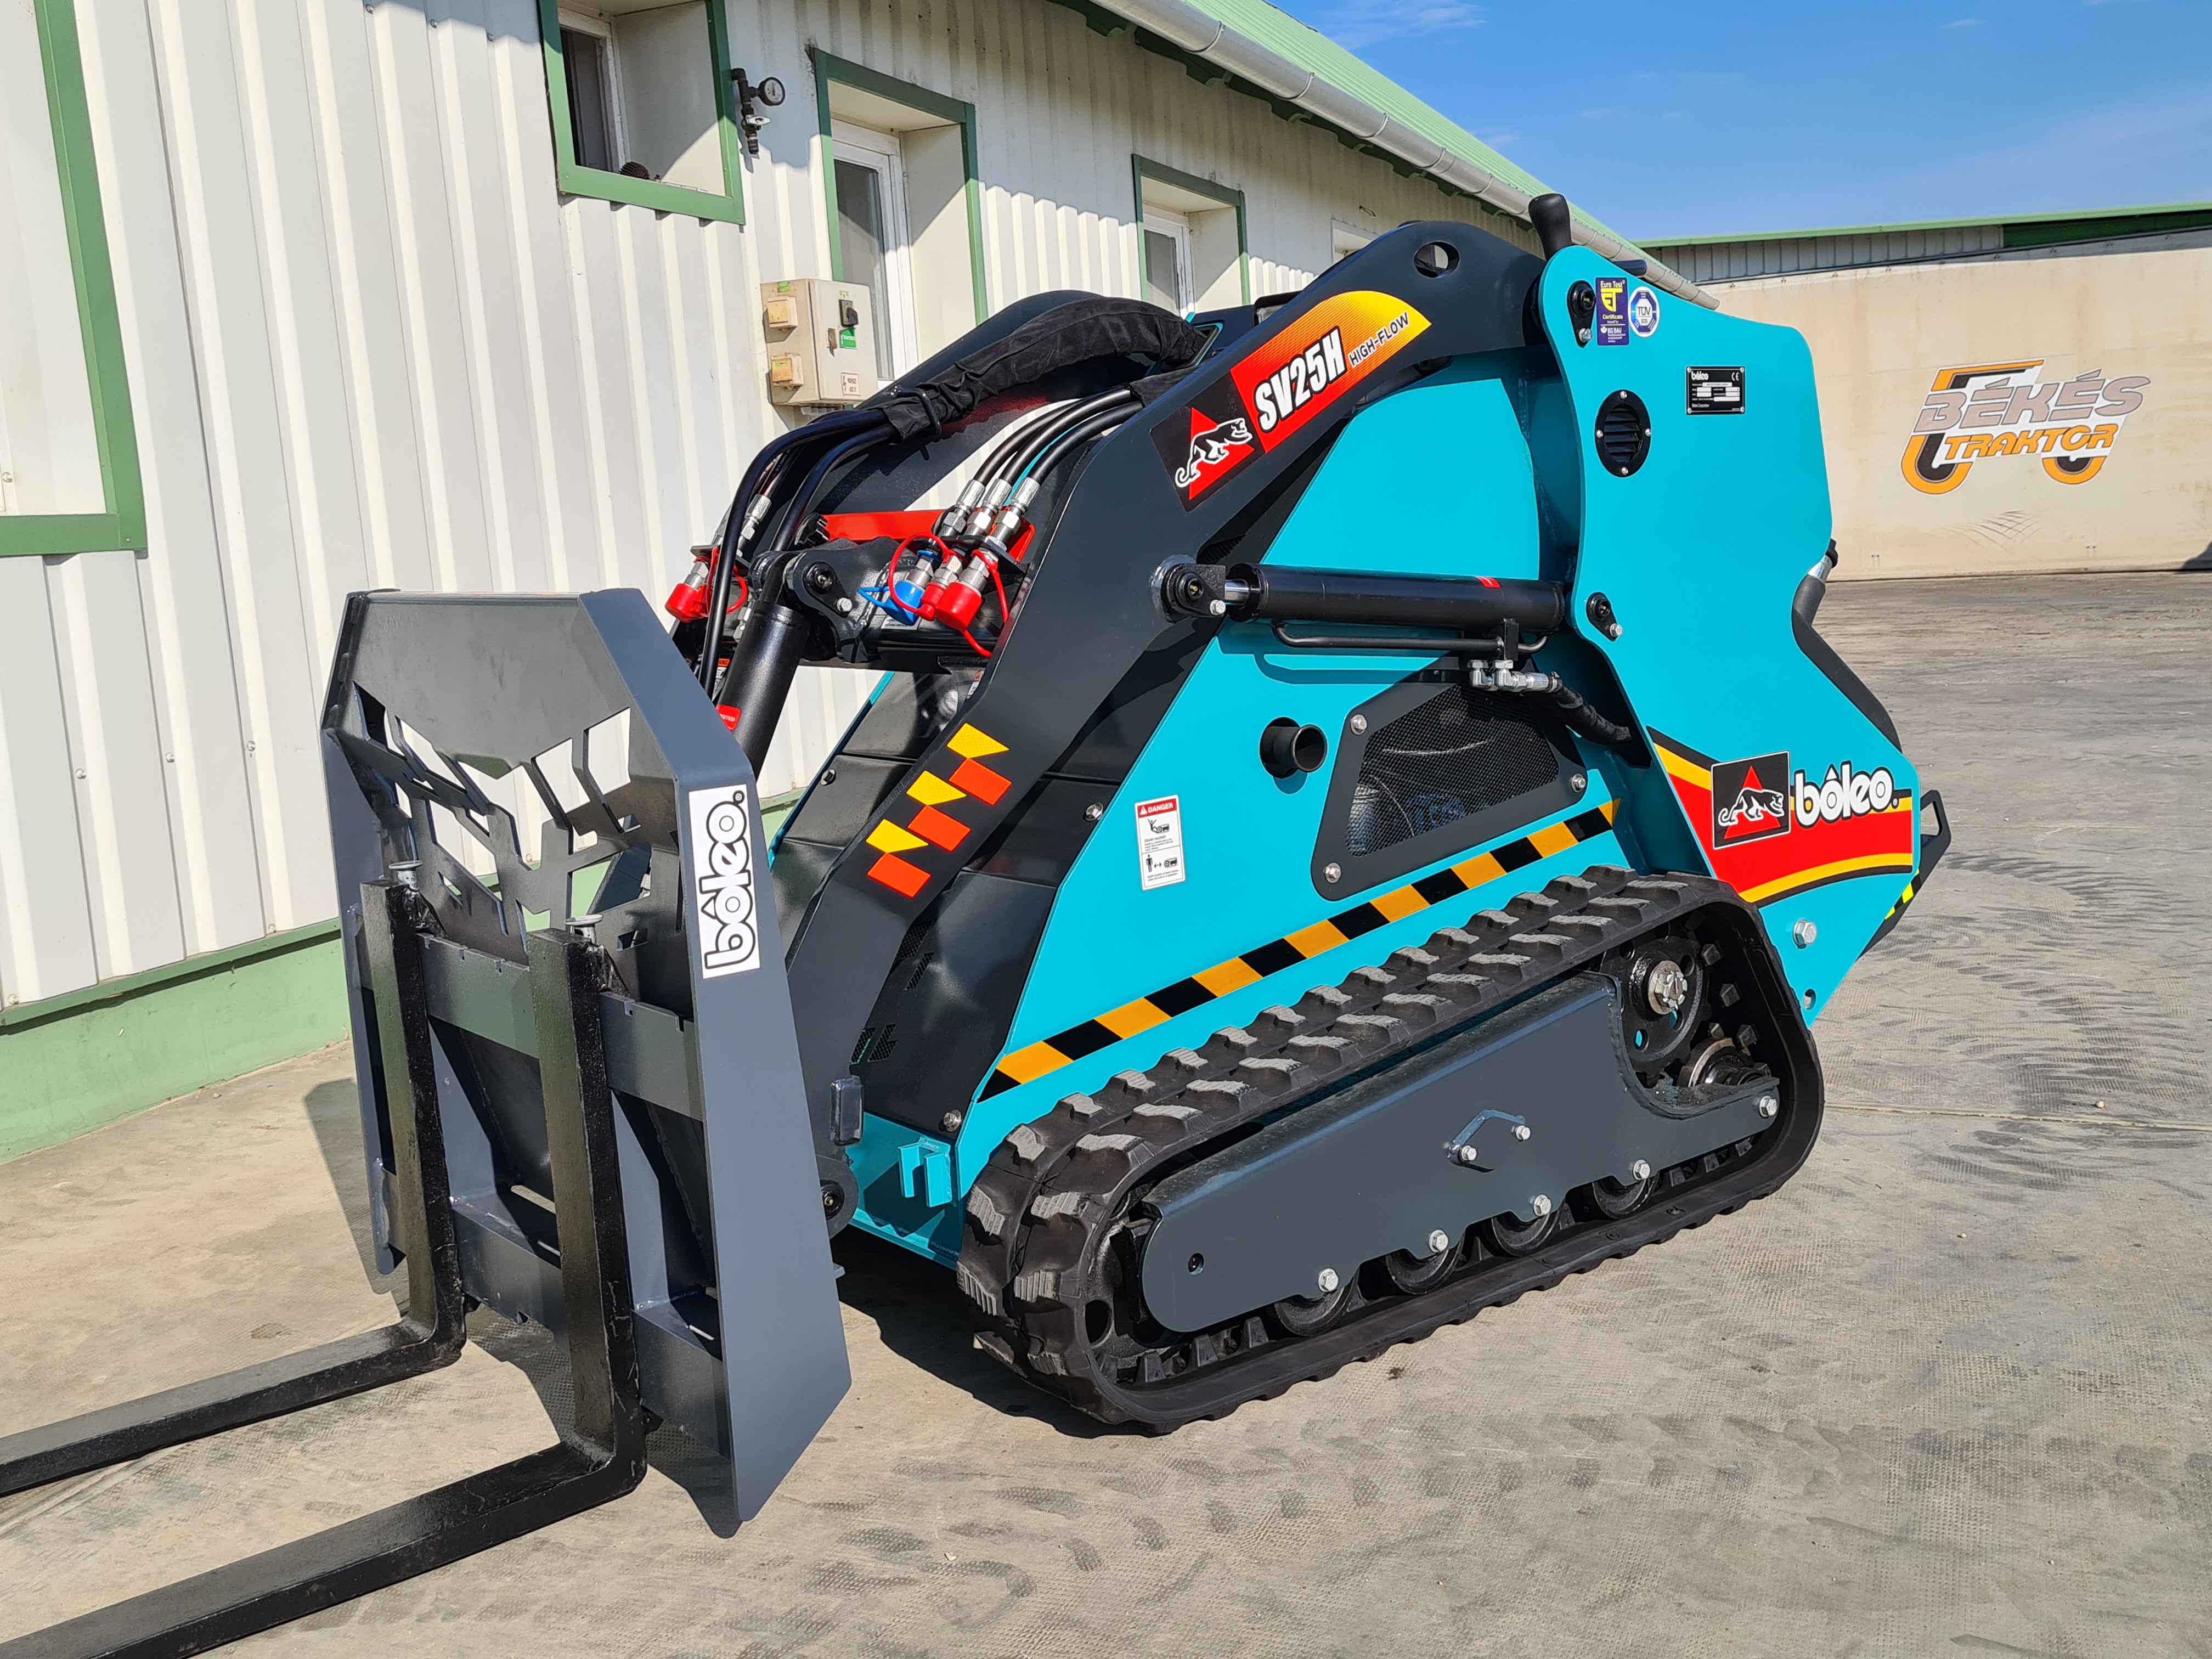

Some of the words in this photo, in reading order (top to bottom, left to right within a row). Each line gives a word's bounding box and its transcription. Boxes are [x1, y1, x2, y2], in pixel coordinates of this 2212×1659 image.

[1255, 327, 1346, 431] SV25H
[1349, 312, 1409, 366] HIGH-FLOW
[1914, 369, 2151, 432] BÉKÉS
[1945, 423, 2119, 460] TRAKTOR
[1148, 802, 1173, 813] DANGER
[1794, 761, 1893, 827] bôleo
